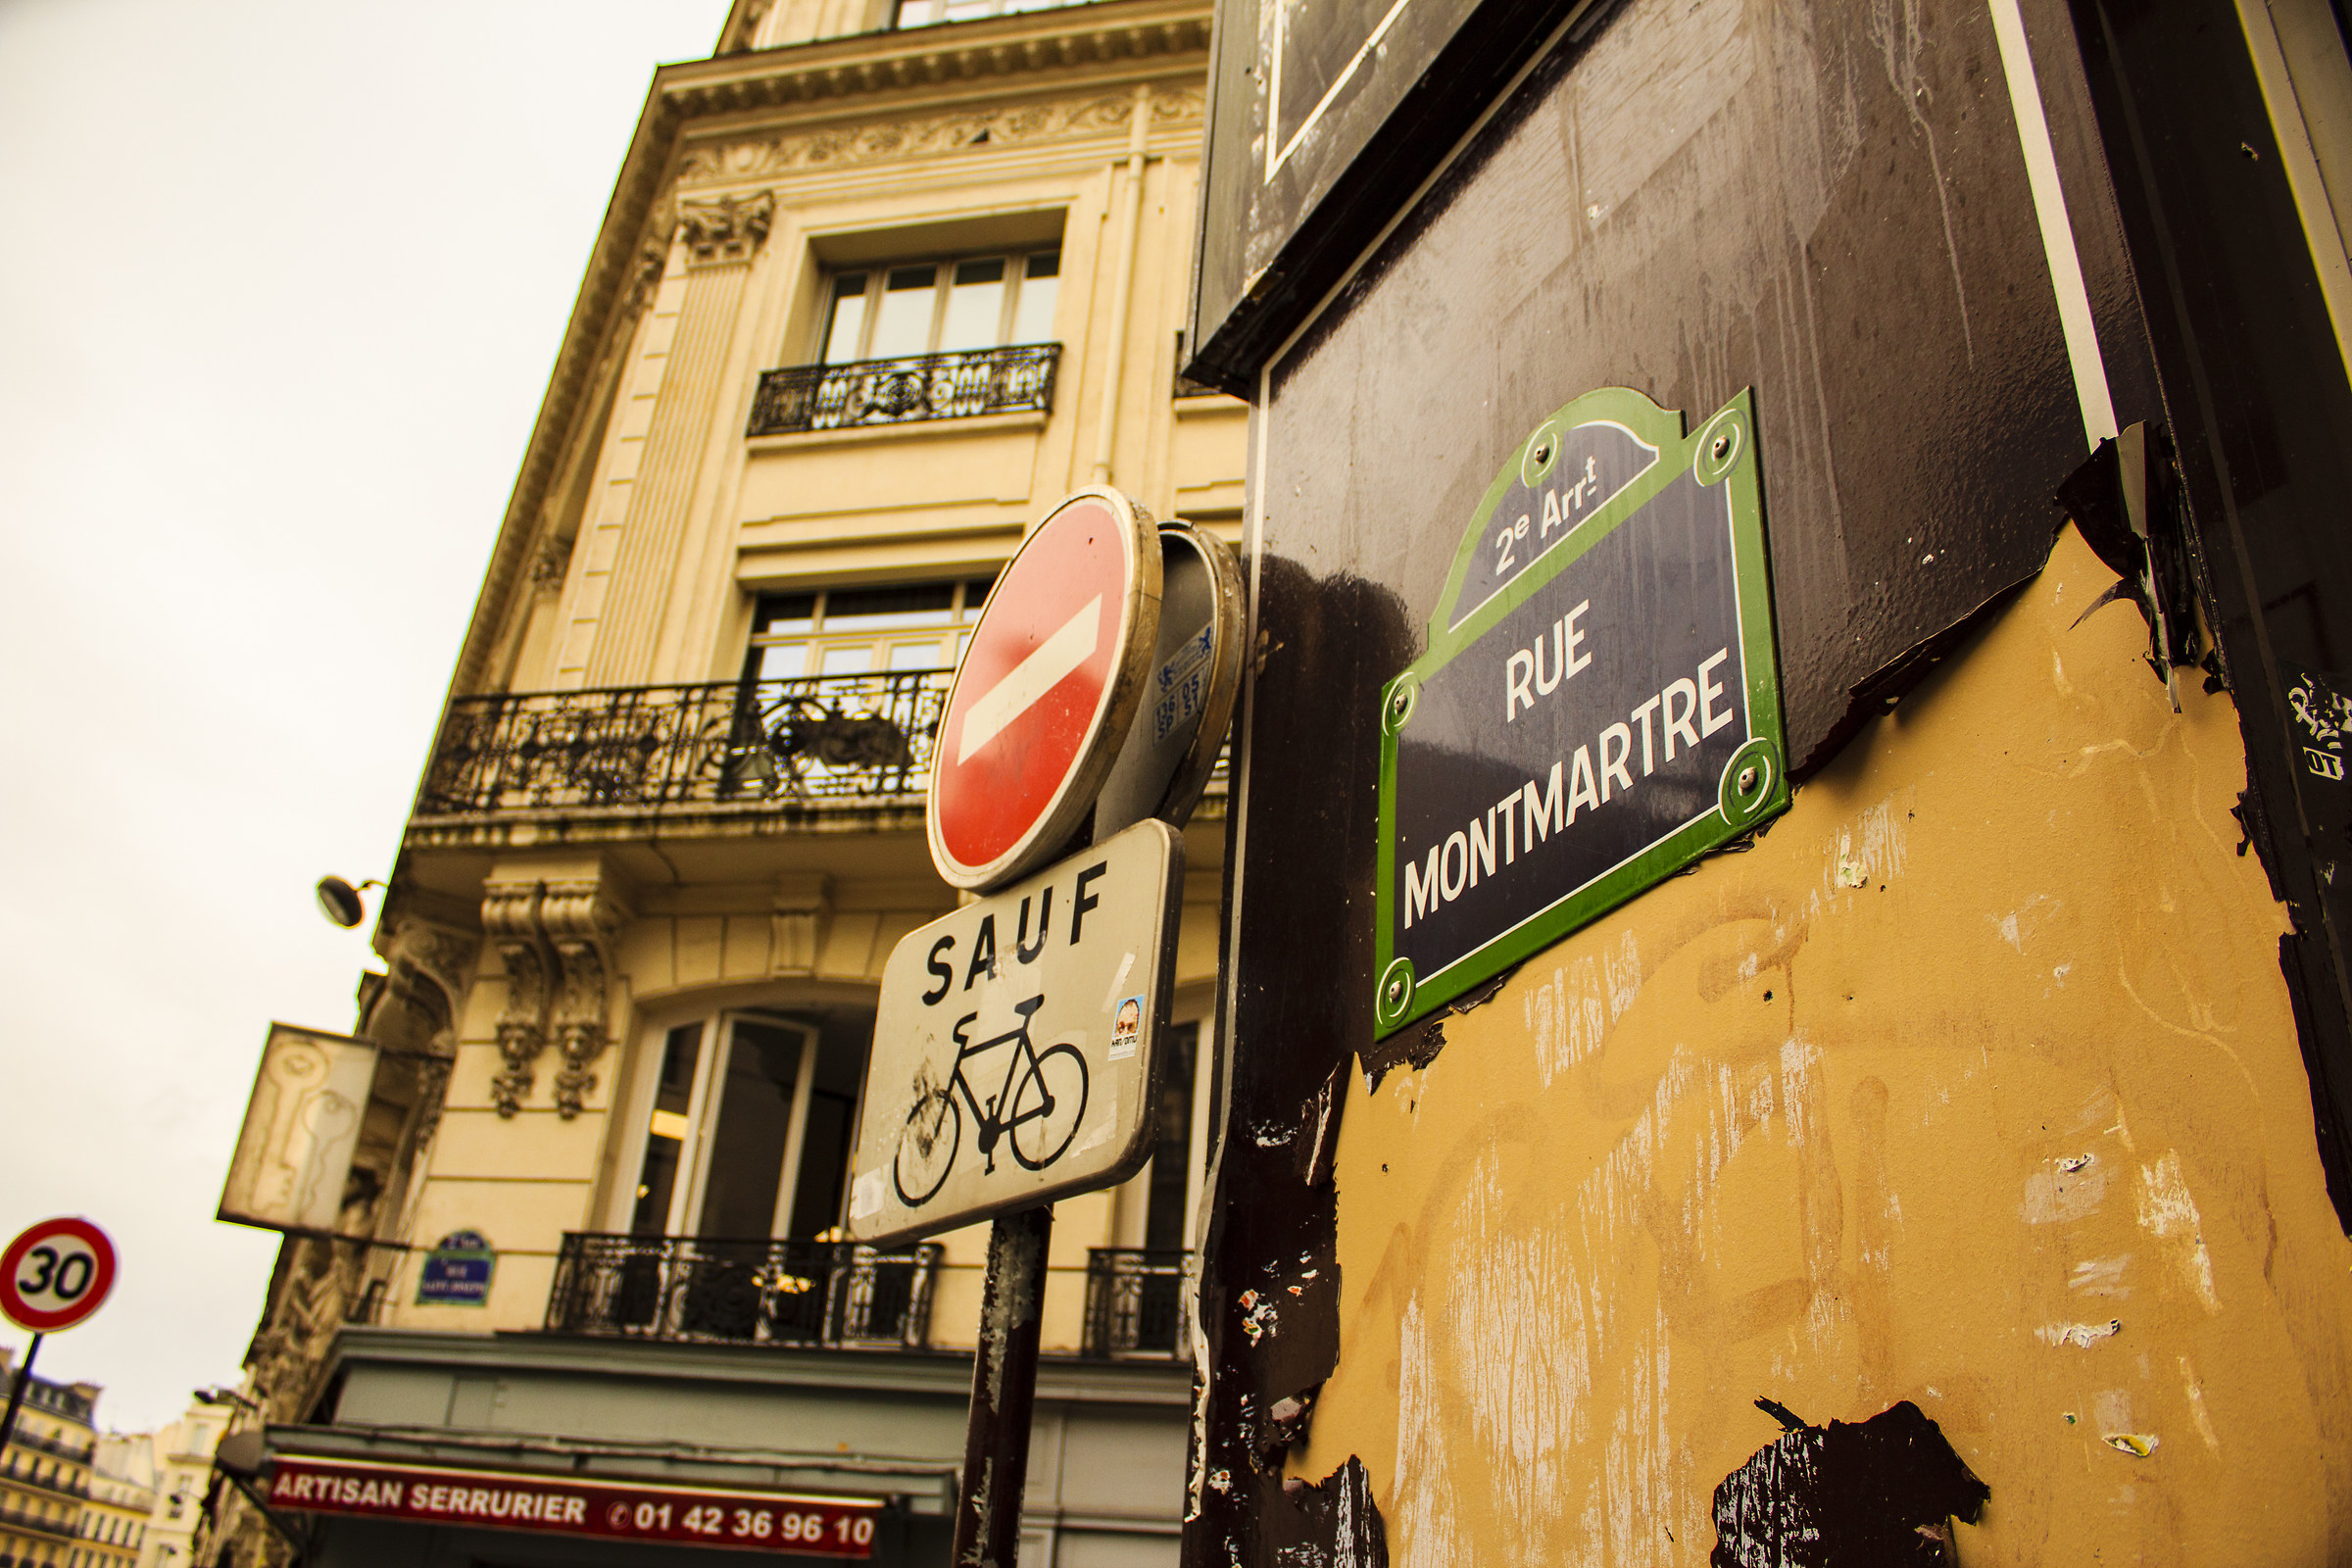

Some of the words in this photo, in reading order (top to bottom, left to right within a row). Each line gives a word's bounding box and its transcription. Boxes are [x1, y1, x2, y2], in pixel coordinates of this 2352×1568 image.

[1495, 514, 1530, 576] 2e
[1505, 599, 1592, 723] RUE
[1403, 647, 1735, 930] MONTMARTRE
[921, 860, 1107, 1006] SAUF
[19, 1246, 93, 1300] 30
[272, 1471, 404, 1508] ARTISAN
[409, 1483, 587, 1524] SERRURIER
[634, 1501, 672, 1531] 01
[683, 1505, 723, 1535] 42
[732, 1508, 772, 1539] 36
[781, 1512, 823, 1542] 96
[834, 1516, 874, 1545] 10
